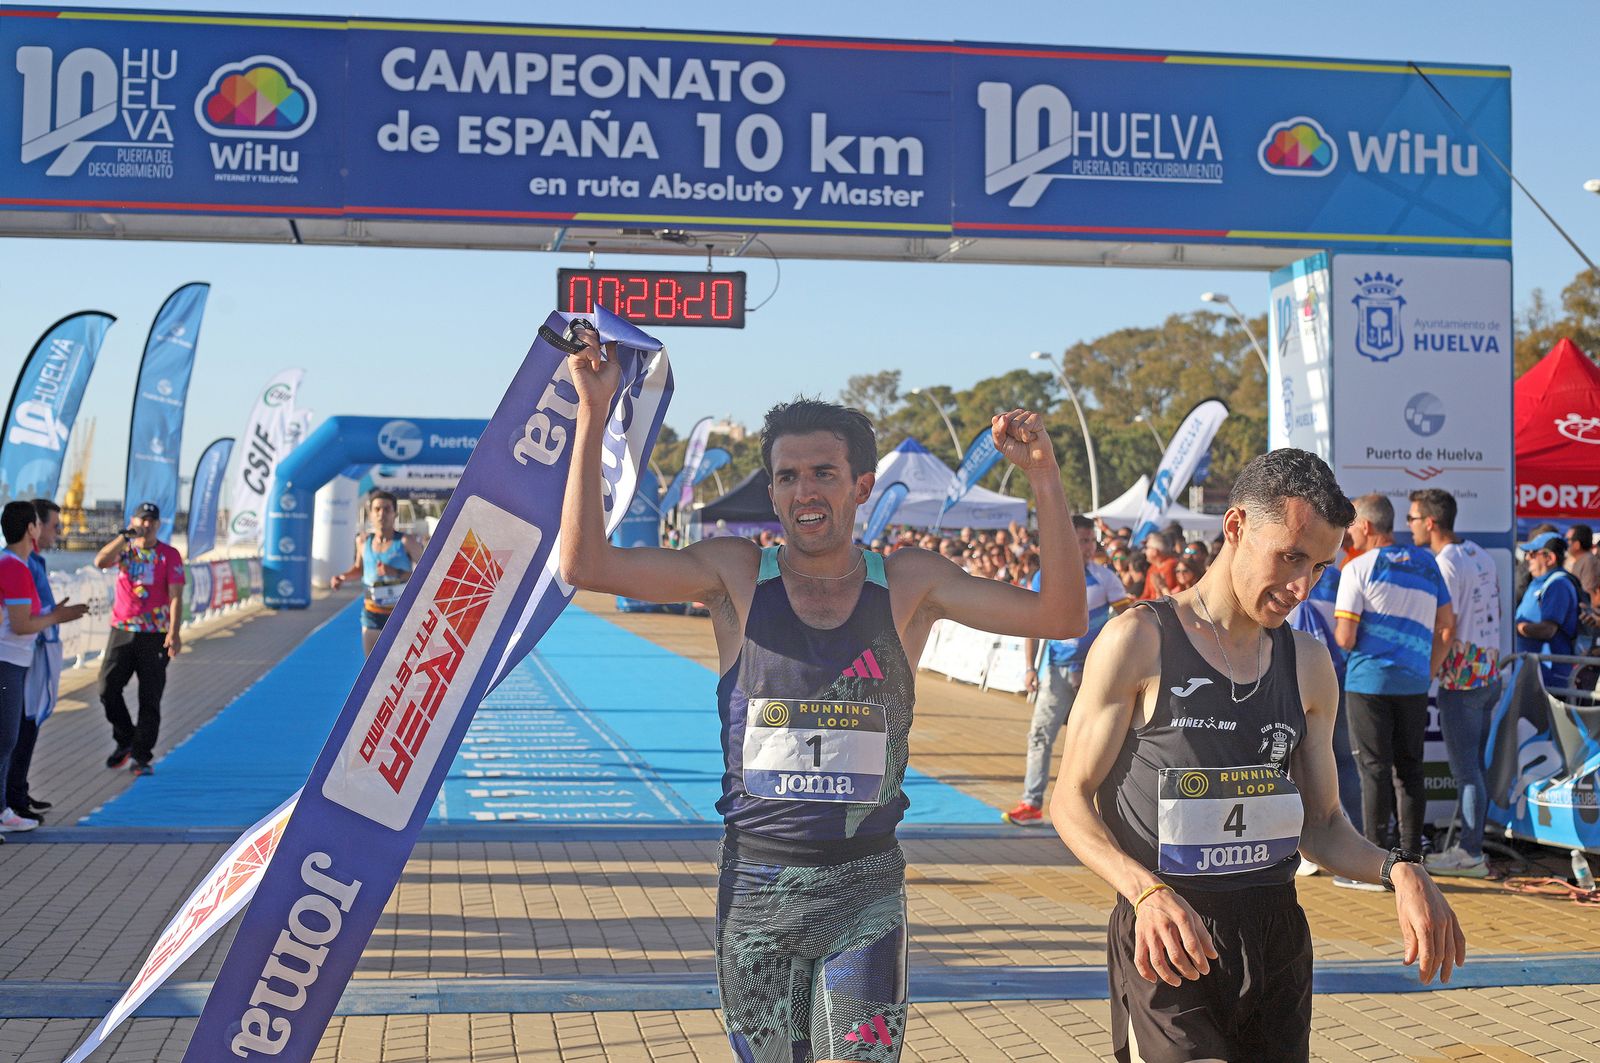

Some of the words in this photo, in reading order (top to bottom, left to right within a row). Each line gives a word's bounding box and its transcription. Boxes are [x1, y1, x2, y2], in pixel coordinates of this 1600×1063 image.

[122, 48, 178, 80] HU
[381, 46, 786, 105] CAMPEONATO
[122, 78, 176, 111] EL
[121, 110, 174, 142] VA
[1072, 111, 1223, 161] HUELVA
[117, 148, 152, 164] PUERTA
[154, 149, 173, 164] DEL
[209, 141, 299, 172] WiHu
[376, 110, 440, 154] de
[457, 109, 660, 160] ESPAÑA
[696, 112, 784, 173] 10
[810, 112, 924, 176] km
[1348, 130, 1479, 177] WiHu
[88, 162, 173, 179] DESCUBRIMIENTO
[214, 173, 250, 183] INTERNET
[1072, 160, 1110, 177] PUERTA
[1112, 161, 1130, 177] DEL
[1133, 162, 1224, 180] DESCUBRIMIENTO
[529, 176, 566, 197] en
[577, 178, 640, 198] ruta
[649, 174, 784, 205] Absoluto
[791, 185, 813, 211] y
[820, 181, 924, 208] Master
[1414, 317, 1486, 332] Ayuntamiento
[1488, 321, 1501, 331] de
[1413, 333, 1500, 354] HUELVA
[32, 337, 75, 408] HUELVA
[243, 423, 278, 496] CSIF
[1366, 447, 1411, 461] Puerto
[1415, 447, 1433, 461] de
[1436, 447, 1483, 462] Huelva
[359, 608, 438, 764] ATLETISMO
[799, 703, 871, 716] RUNNING
[817, 717, 860, 728] LOOP
[1170, 716, 1204, 728] NÚÑEZ
[1218, 720, 1237, 731] RUN
[1260, 723, 1273, 734] CLUB
[805, 734, 823, 768] 1
[774, 773, 855, 795] Joma
[1220, 768, 1281, 783] RUNNING
[1237, 783, 1276, 795] LOOP
[1223, 803, 1247, 838] 4
[1196, 843, 1270, 871] Joma
[231, 851, 362, 1059] Joma
